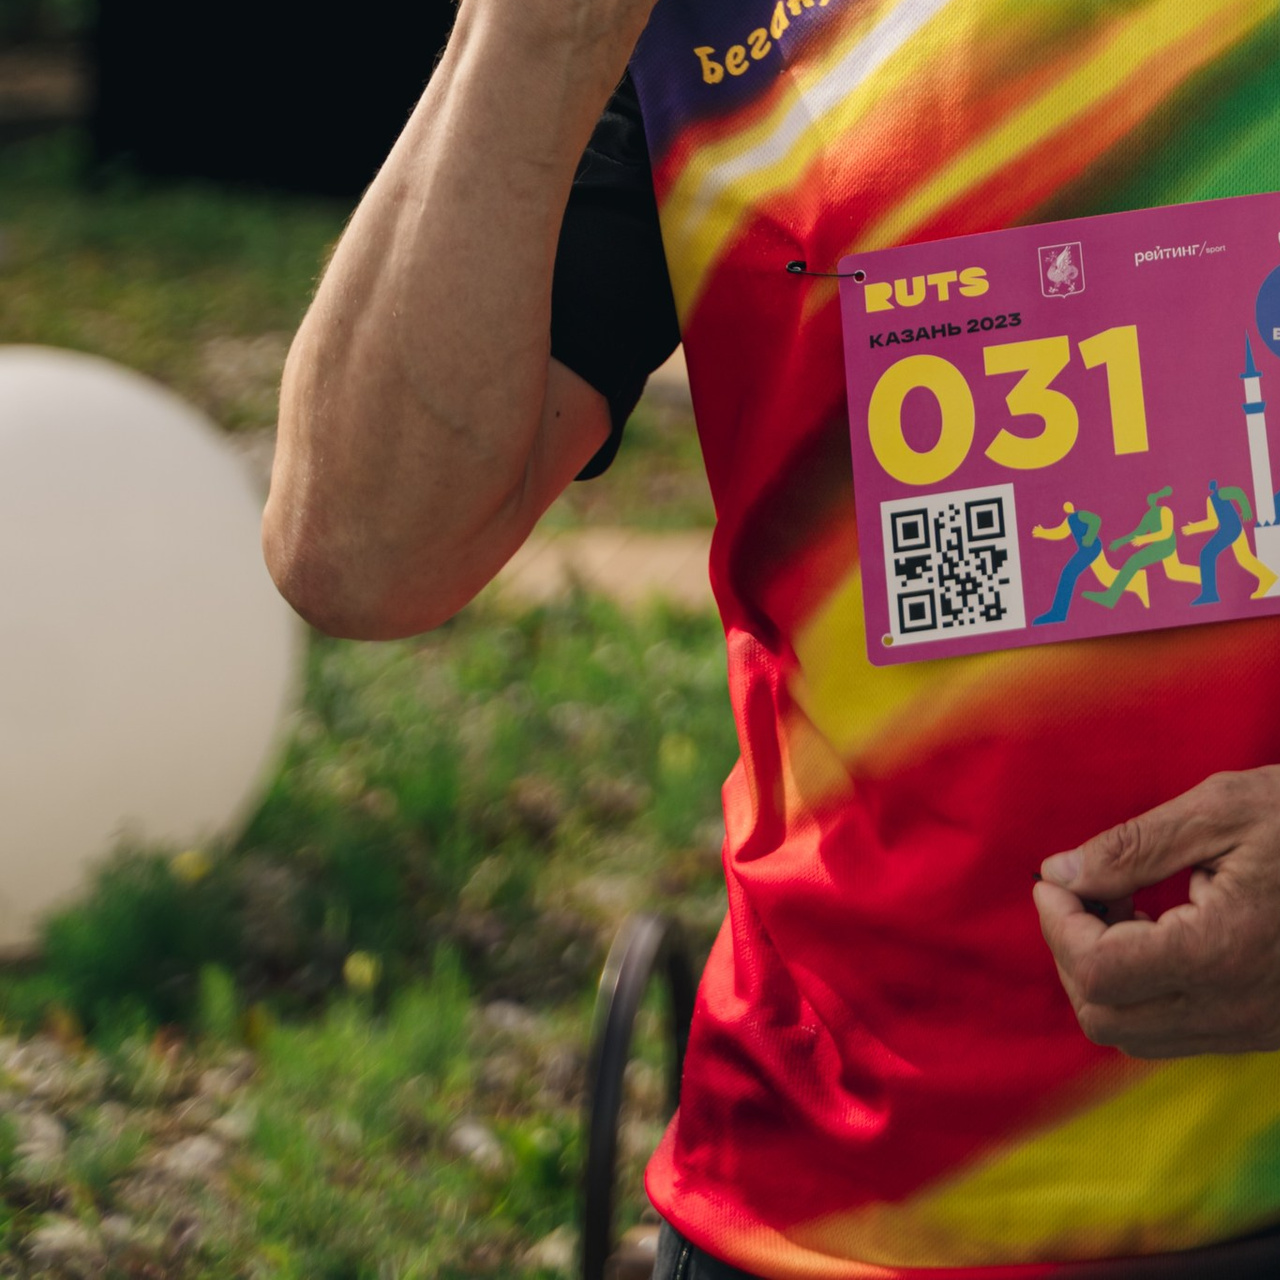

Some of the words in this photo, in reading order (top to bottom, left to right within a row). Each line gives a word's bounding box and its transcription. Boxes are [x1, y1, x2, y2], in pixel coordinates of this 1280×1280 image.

[864, 266, 990, 313] RUTS
[869, 322, 962, 349] КАЗАНЬ
[966, 312, 1022, 334] 2023
[867, 324, 1149, 486] 031
